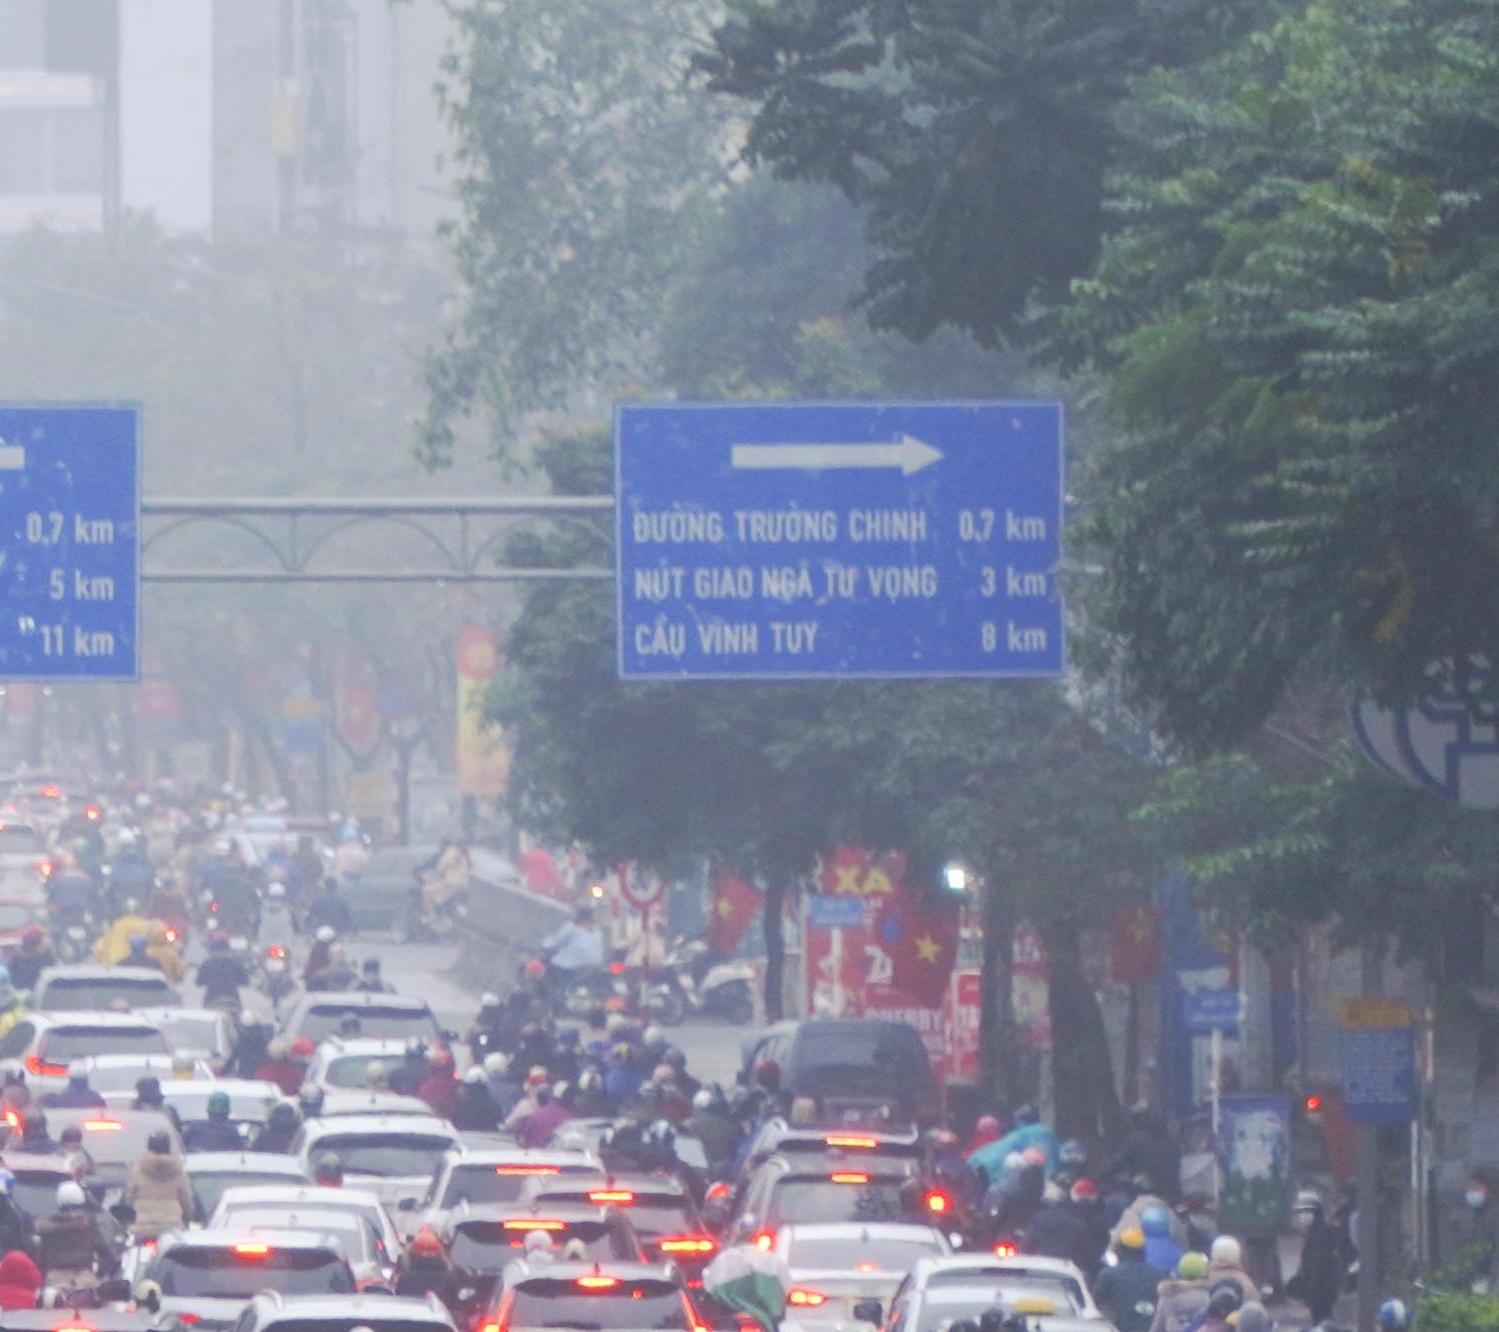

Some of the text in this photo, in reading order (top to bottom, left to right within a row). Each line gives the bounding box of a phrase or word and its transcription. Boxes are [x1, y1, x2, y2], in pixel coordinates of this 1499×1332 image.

[76, 513, 114, 543] km
[634, 502, 723, 542] ĐƯỜNG
[734, 502, 837, 542] TRƯỜNG
[849, 511, 926, 541] CHINH
[1006, 511, 1045, 541] km
[49, 570, 65, 600] 5
[76, 570, 114, 600] km
[635, 559, 685, 599] NÚT
[694, 568, 753, 598] GIAO
[868, 566, 937, 604] VỌNG
[981, 567, 995, 597] 3
[1007, 567, 1046, 597] km
[41, 626, 64, 655] 11
[76, 626, 114, 656] km
[635, 614, 685, 655] CẦU
[982, 622, 996, 652] 8
[1007, 622, 1046, 652] km
